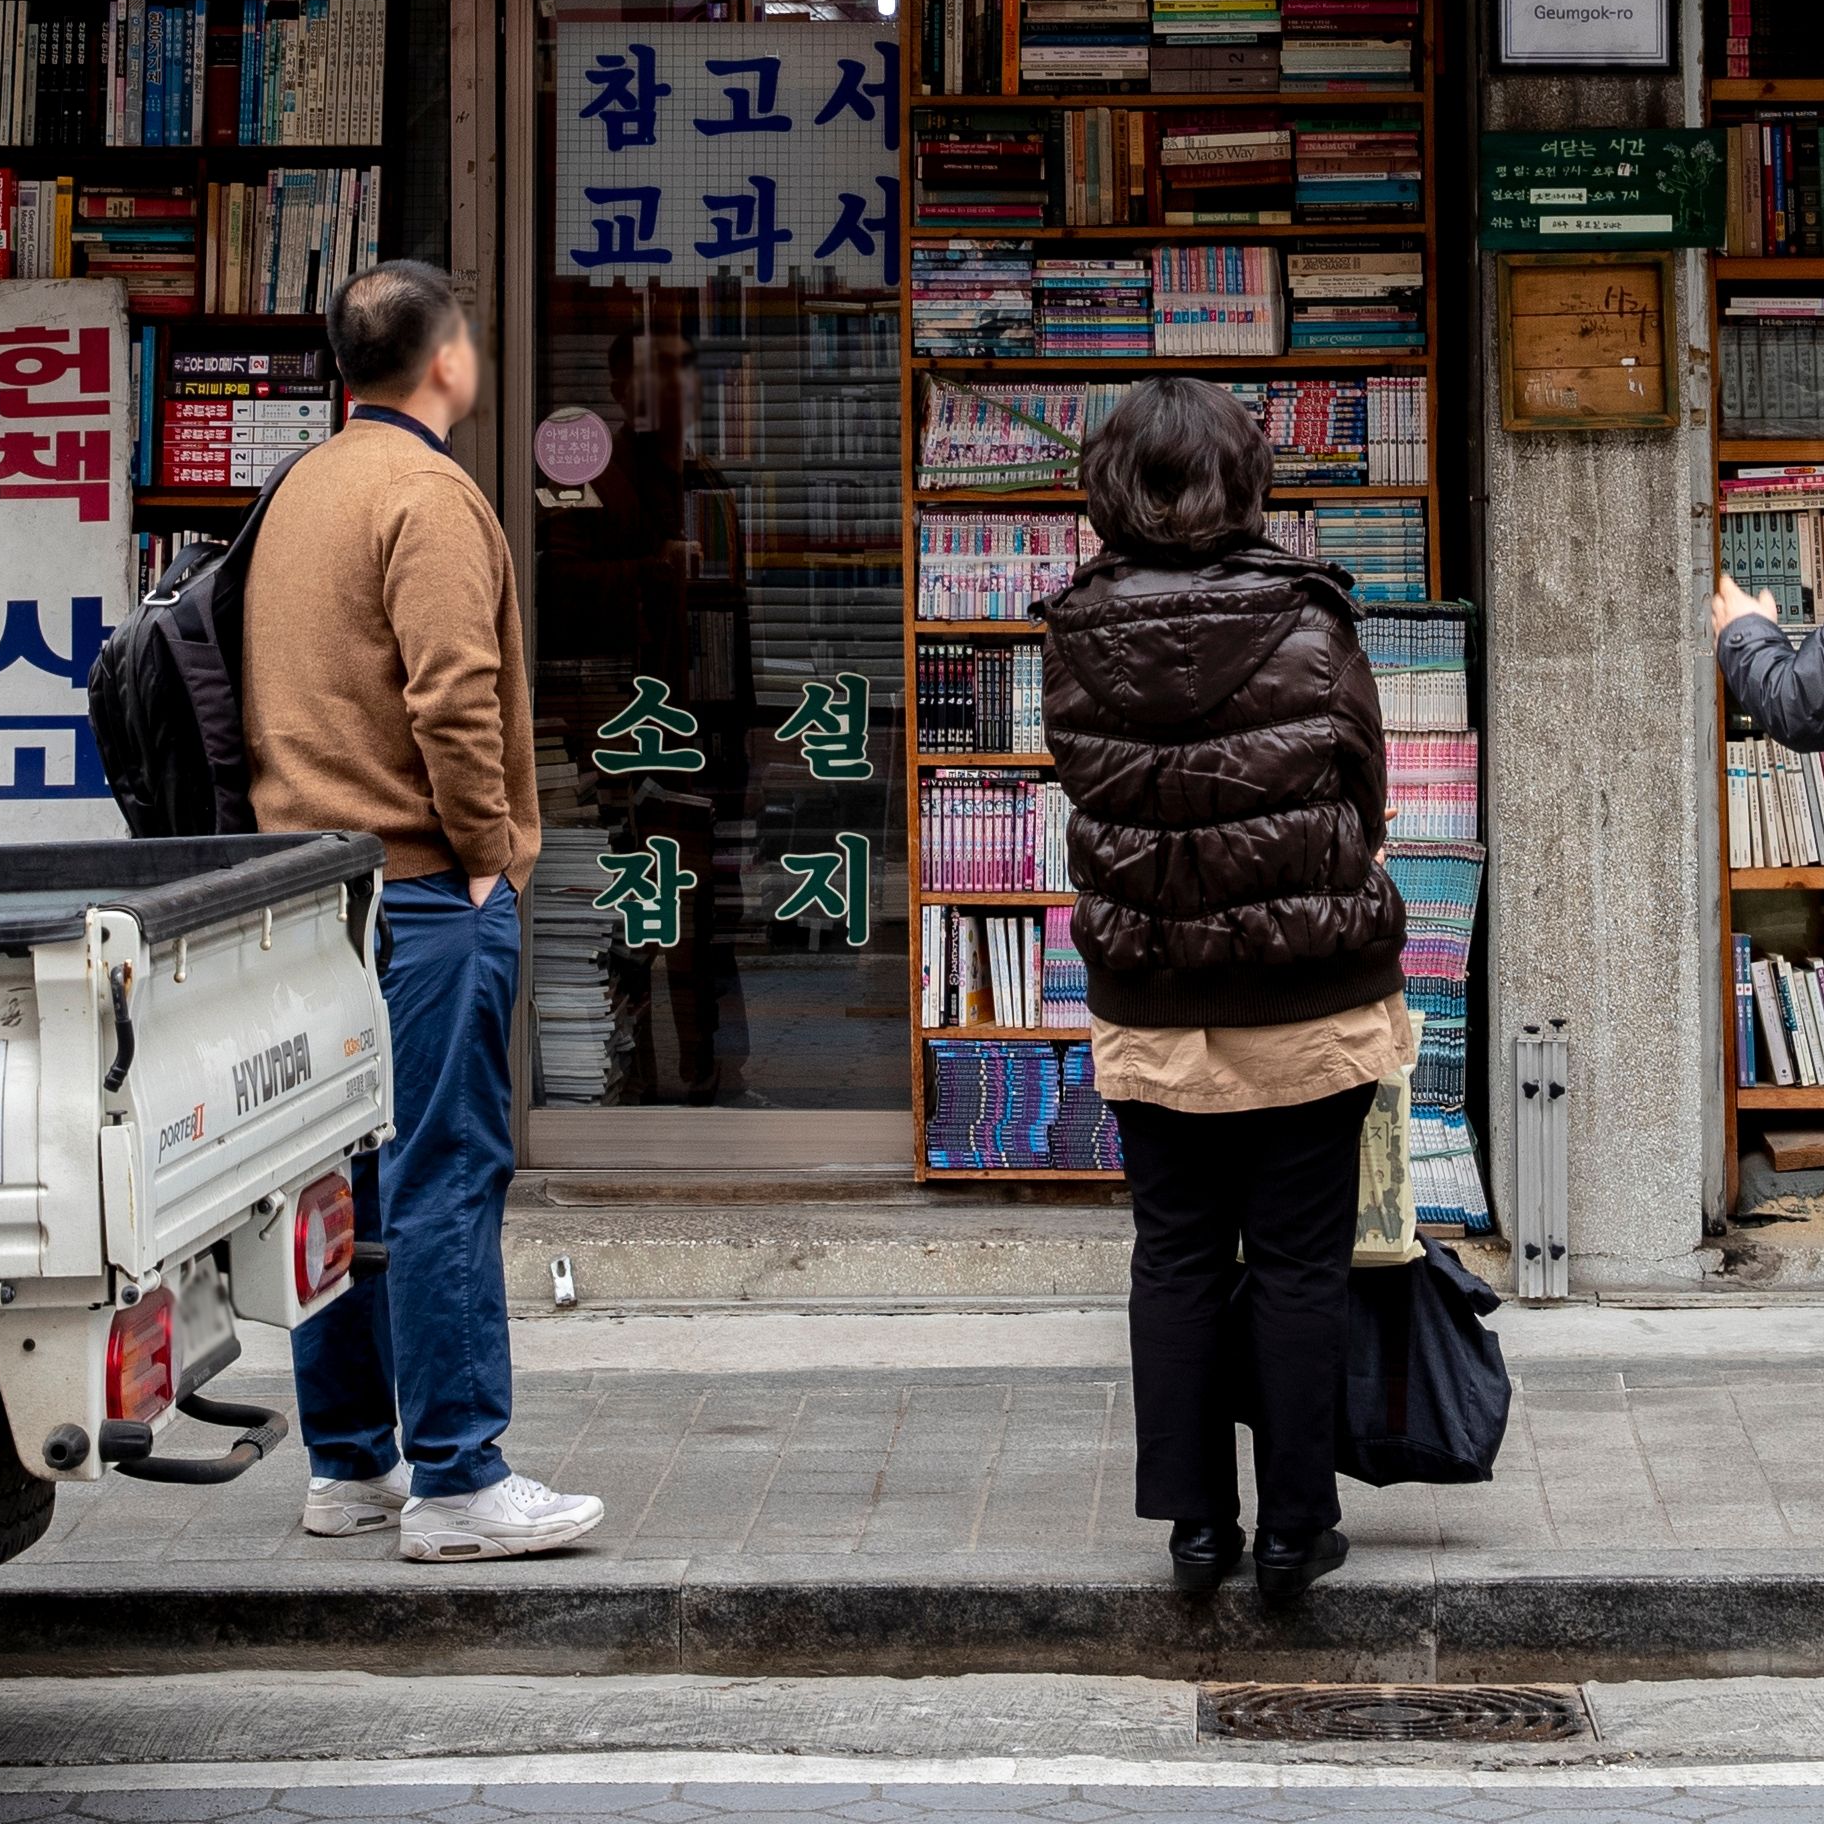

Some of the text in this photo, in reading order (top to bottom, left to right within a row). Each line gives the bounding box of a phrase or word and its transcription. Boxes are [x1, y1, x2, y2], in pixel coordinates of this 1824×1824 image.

[1534, 4, 1633, 23] Geumgok-ro
[579, 42, 900, 152] 참고서
[1186, 146, 1256, 162] Mao's Way
[1541, 139, 1646, 158] 여닫는 시간
[570, 175, 900, 286] 교과서
[592, 671, 874, 781] 소설
[592, 831, 871, 948] 잡지
[232, 1032, 311, 1116] HYUNDAI
[158, 1112, 197, 1163] PORTER
